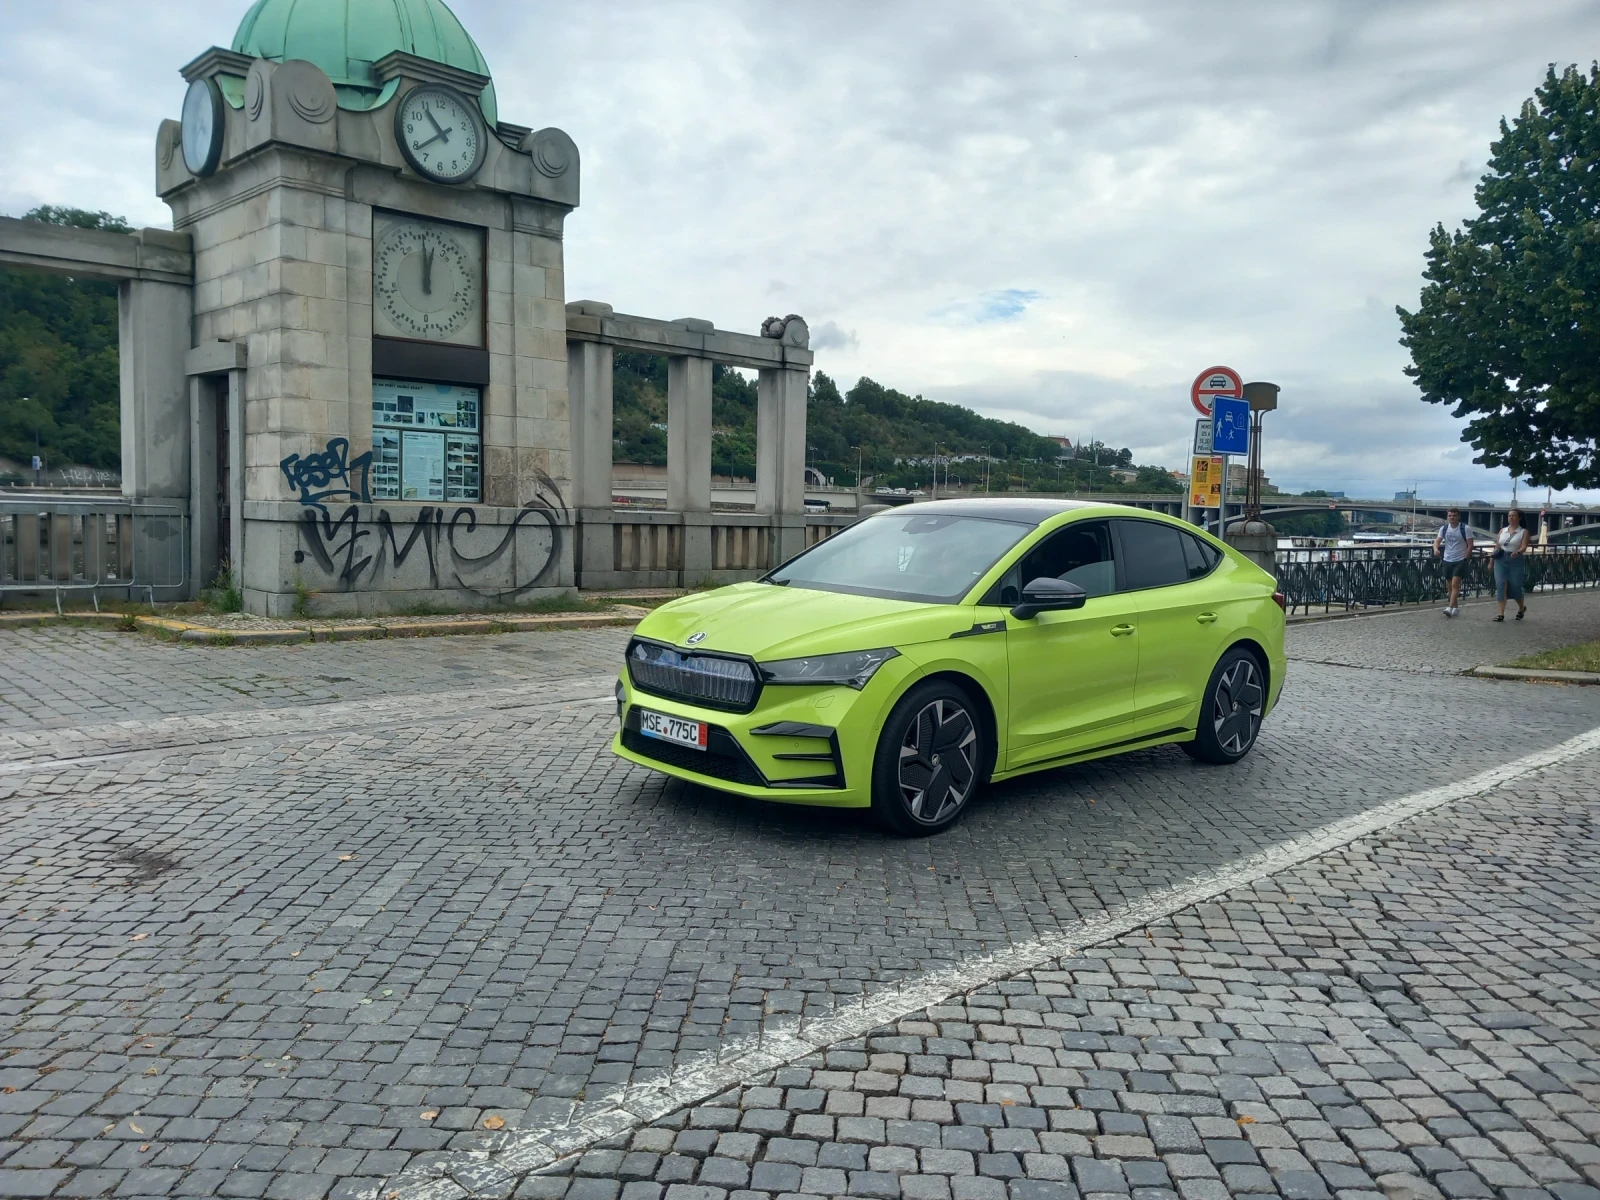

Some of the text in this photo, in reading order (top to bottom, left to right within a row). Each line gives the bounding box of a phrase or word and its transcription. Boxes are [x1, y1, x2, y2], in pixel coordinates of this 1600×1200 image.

[421, 101, 430, 110] 11
[436, 99, 446, 109] 12
[411, 111, 423, 121] 10
[452, 109, 456, 117] 1
[406, 124, 414, 133] 9
[461, 122, 467, 130] 2
[412, 141, 420, 150] 8
[466, 138, 472, 147] 3
[422, 153, 429, 162] 7
[461, 152, 467, 160] 4
[437, 162, 443, 171] 6
[452, 161, 458, 170] 5
[424, 314, 428, 322] 0
[642, 712, 697, 742] MSE 775C
